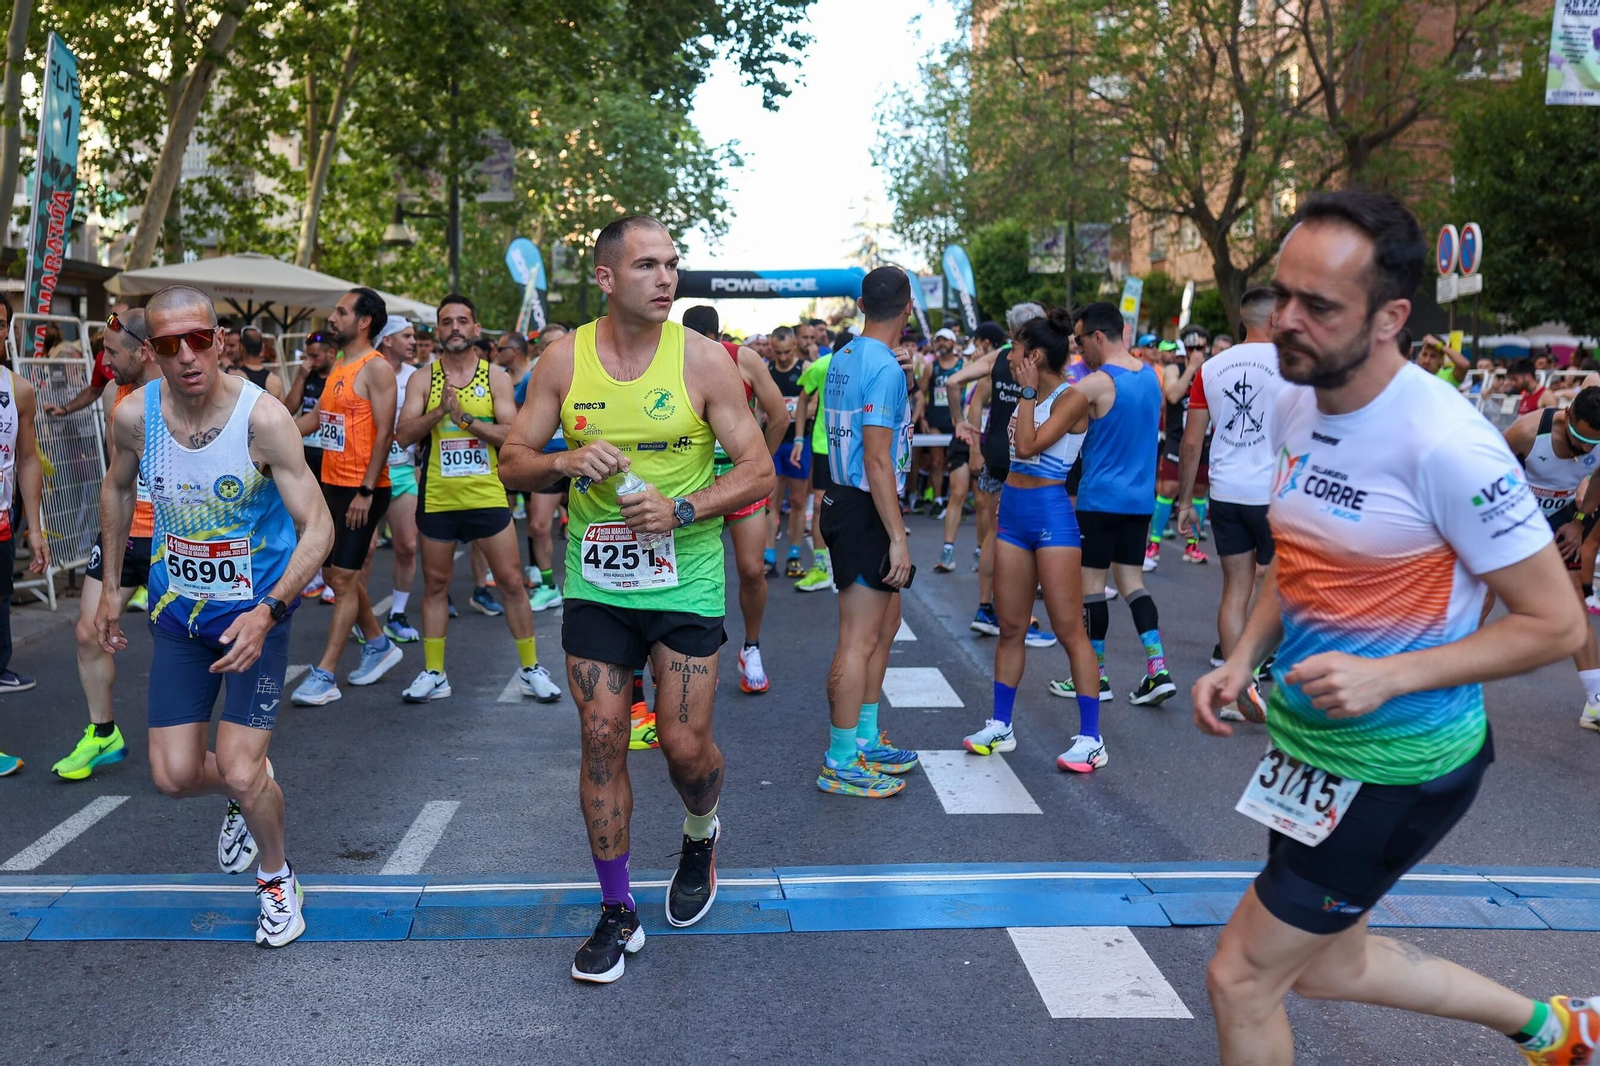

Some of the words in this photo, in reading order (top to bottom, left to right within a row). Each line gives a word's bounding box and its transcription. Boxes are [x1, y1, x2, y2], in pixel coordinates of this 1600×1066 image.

[63, 105, 72, 148] 1
[711, 277, 818, 293] POWERADE
[442, 450, 483, 466] 3096
[1304, 475, 1368, 511] CORRE
[586, 527, 601, 541] 41
[168, 537, 179, 553] 41
[583, 543, 656, 570] 4251
[168, 553, 236, 584] 5690
[669, 661, 708, 675] JUANA
[679, 655, 692, 723] PAULINO
